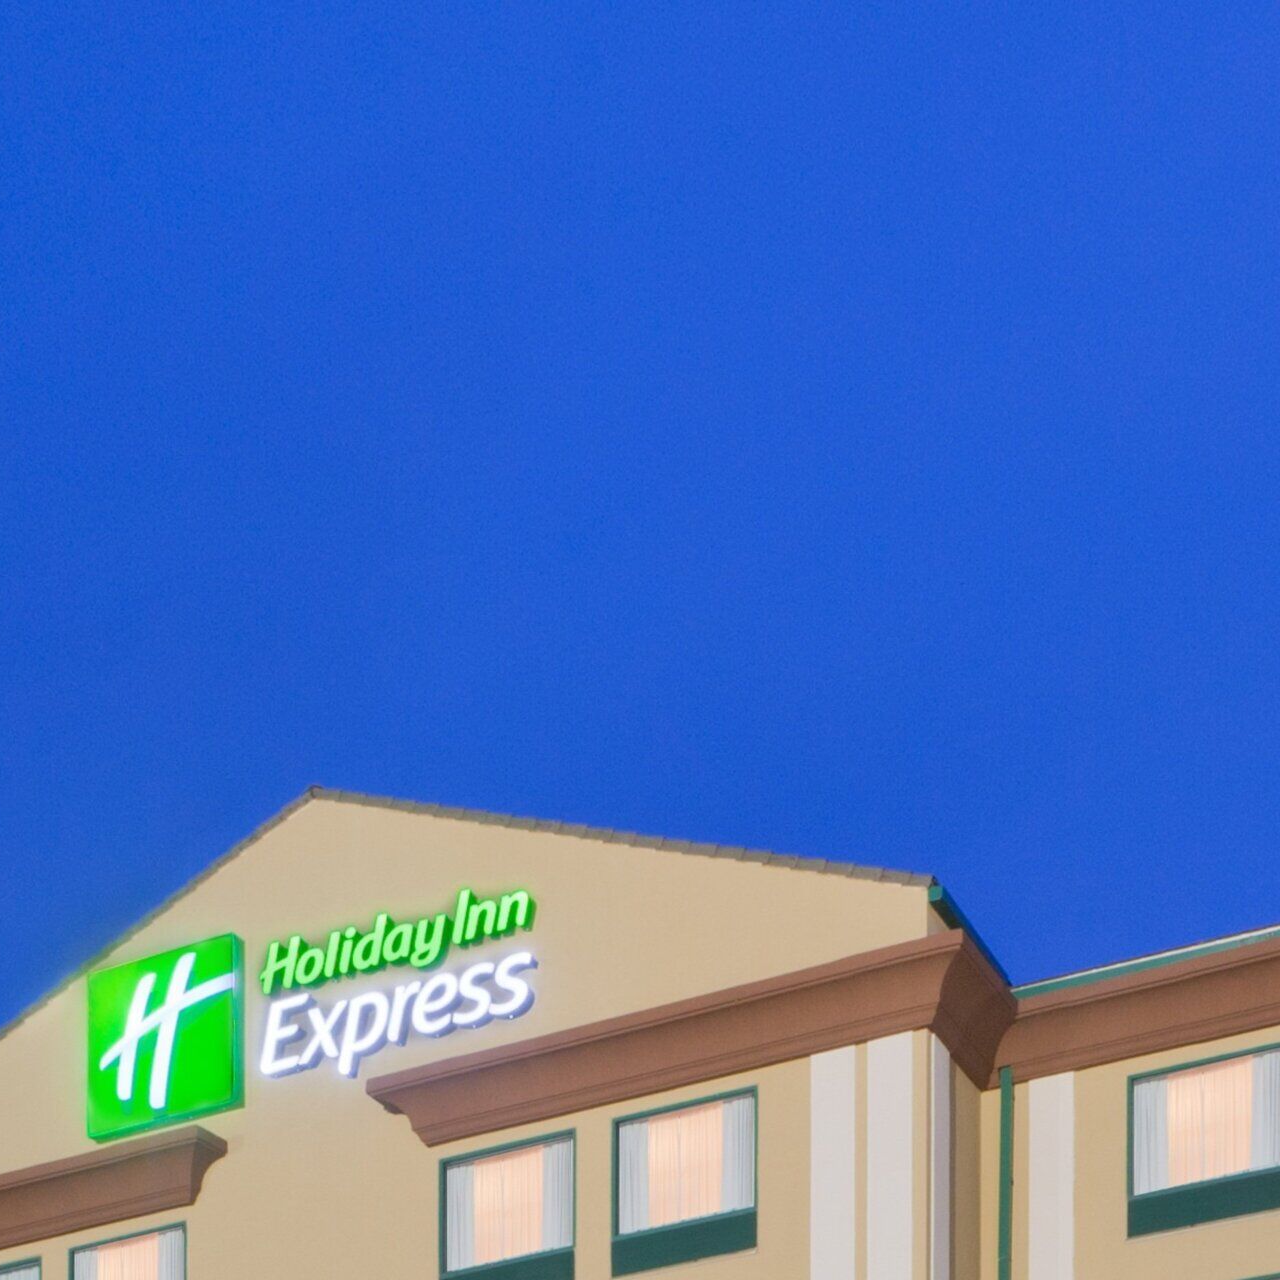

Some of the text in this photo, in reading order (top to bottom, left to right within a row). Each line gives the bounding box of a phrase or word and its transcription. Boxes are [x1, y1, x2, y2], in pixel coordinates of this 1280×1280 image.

[260, 889, 534, 994] Holiday Inn
[260, 952, 536, 1077] Express
